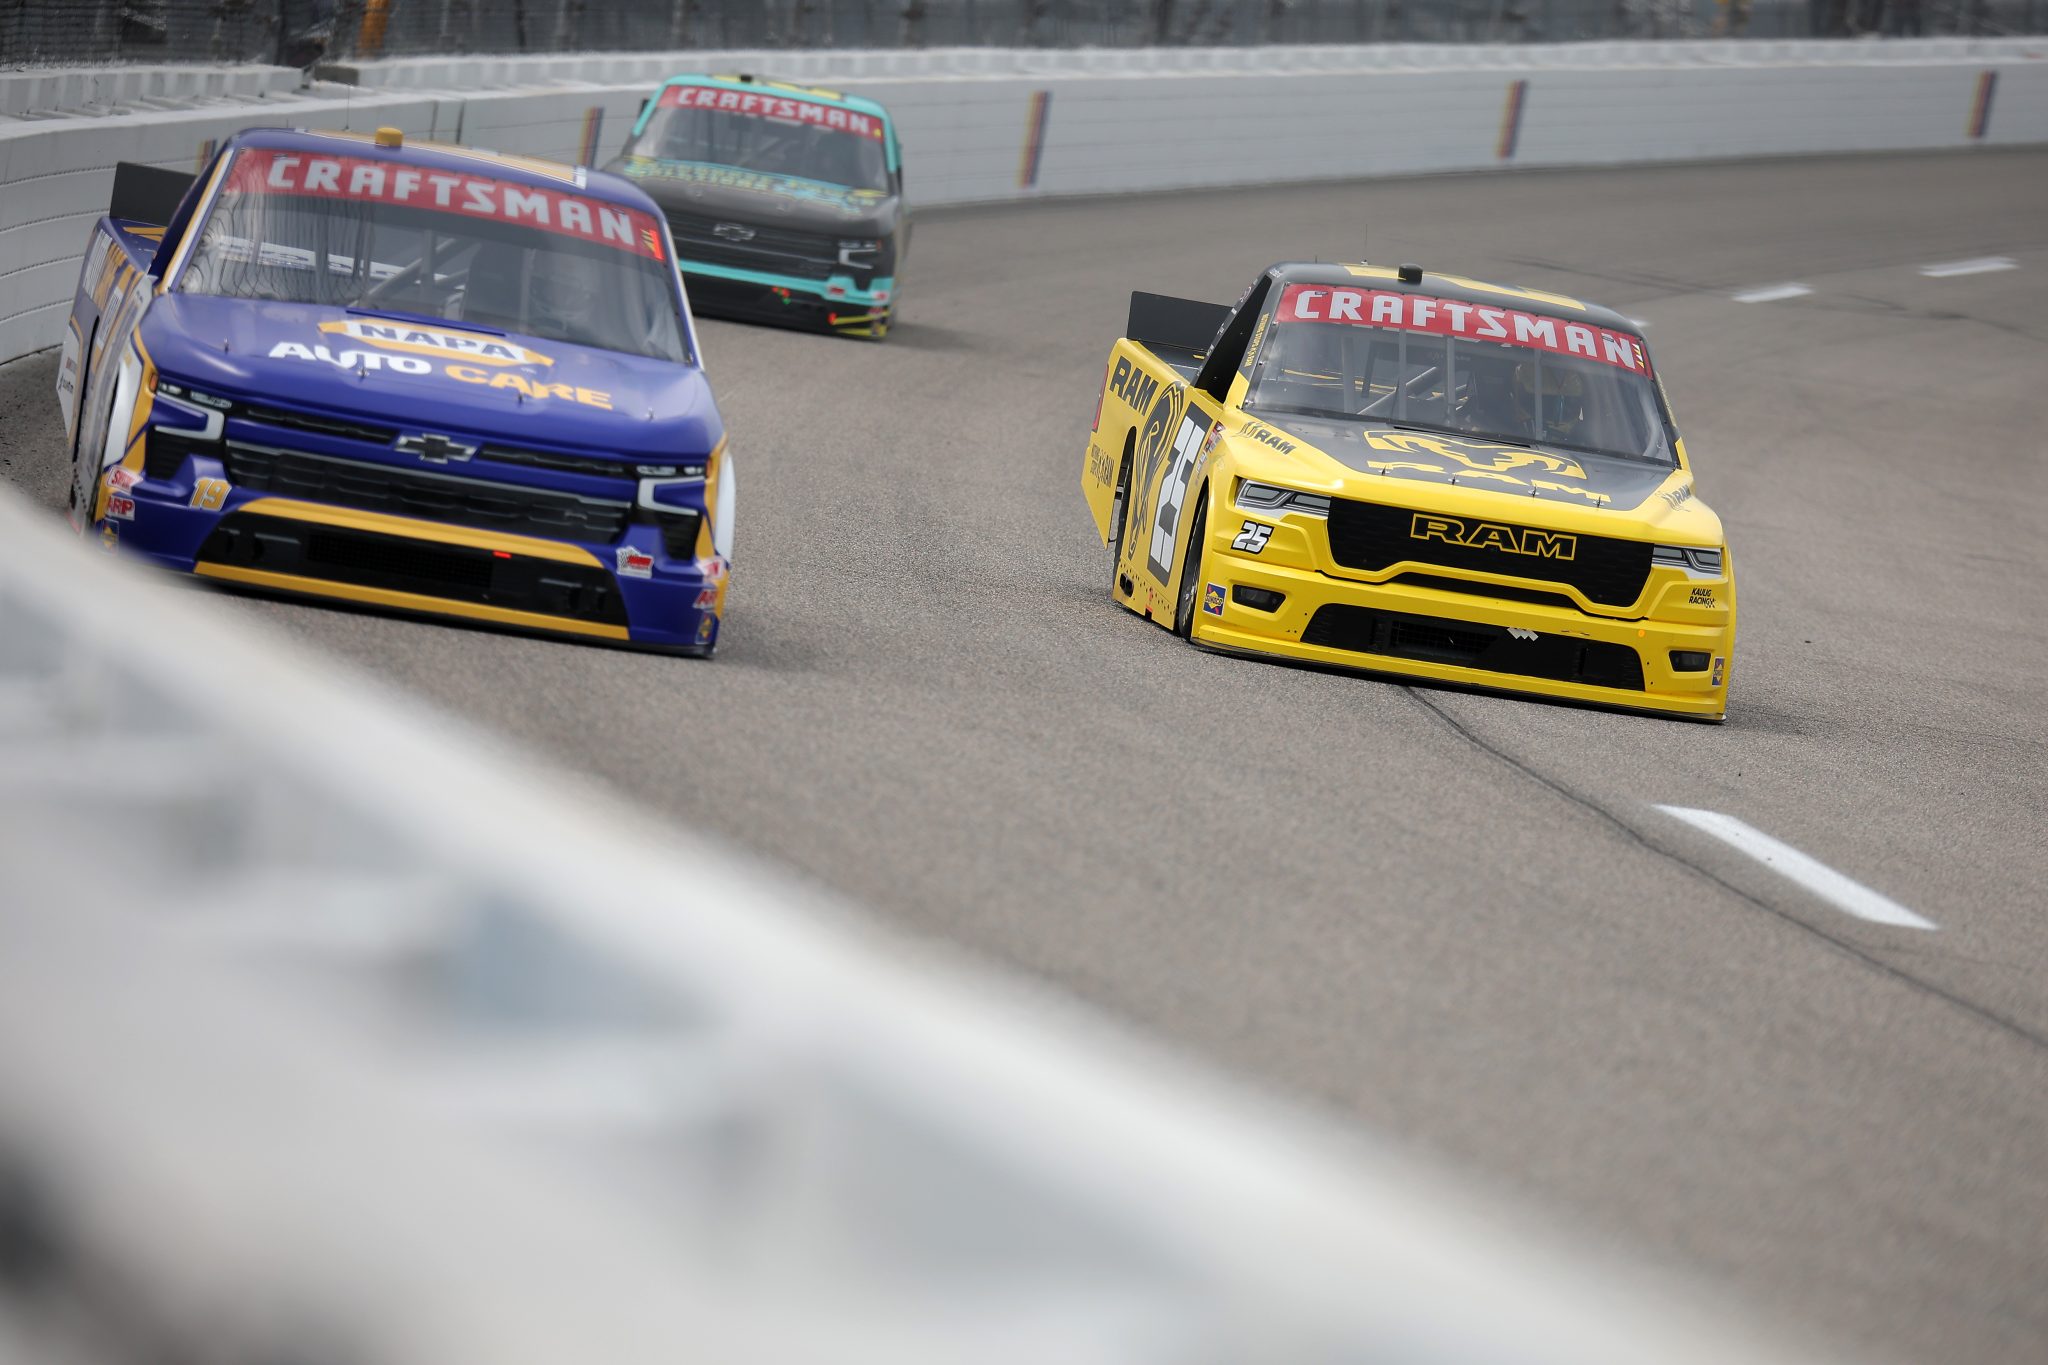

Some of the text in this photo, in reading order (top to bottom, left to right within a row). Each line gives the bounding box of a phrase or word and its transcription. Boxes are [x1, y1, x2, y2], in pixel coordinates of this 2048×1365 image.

[678, 88, 870, 133] CRAFTSMAN
[266, 157, 636, 247] CRAFTSMAN
[358, 323, 518, 360] NAPA
[1294, 289, 1641, 370] CRAFTSMAN
[268, 341, 614, 411] AUTO CARE
[1109, 355, 1160, 417] RAM
[1253, 428, 1297, 456] RAM
[189, 476, 233, 512] 19
[1230, 519, 1275, 555] 25
[1410, 512, 1578, 562] RAM
[1688, 596, 1711, 606] RACING
[1691, 587, 1712, 597] KAULIG
